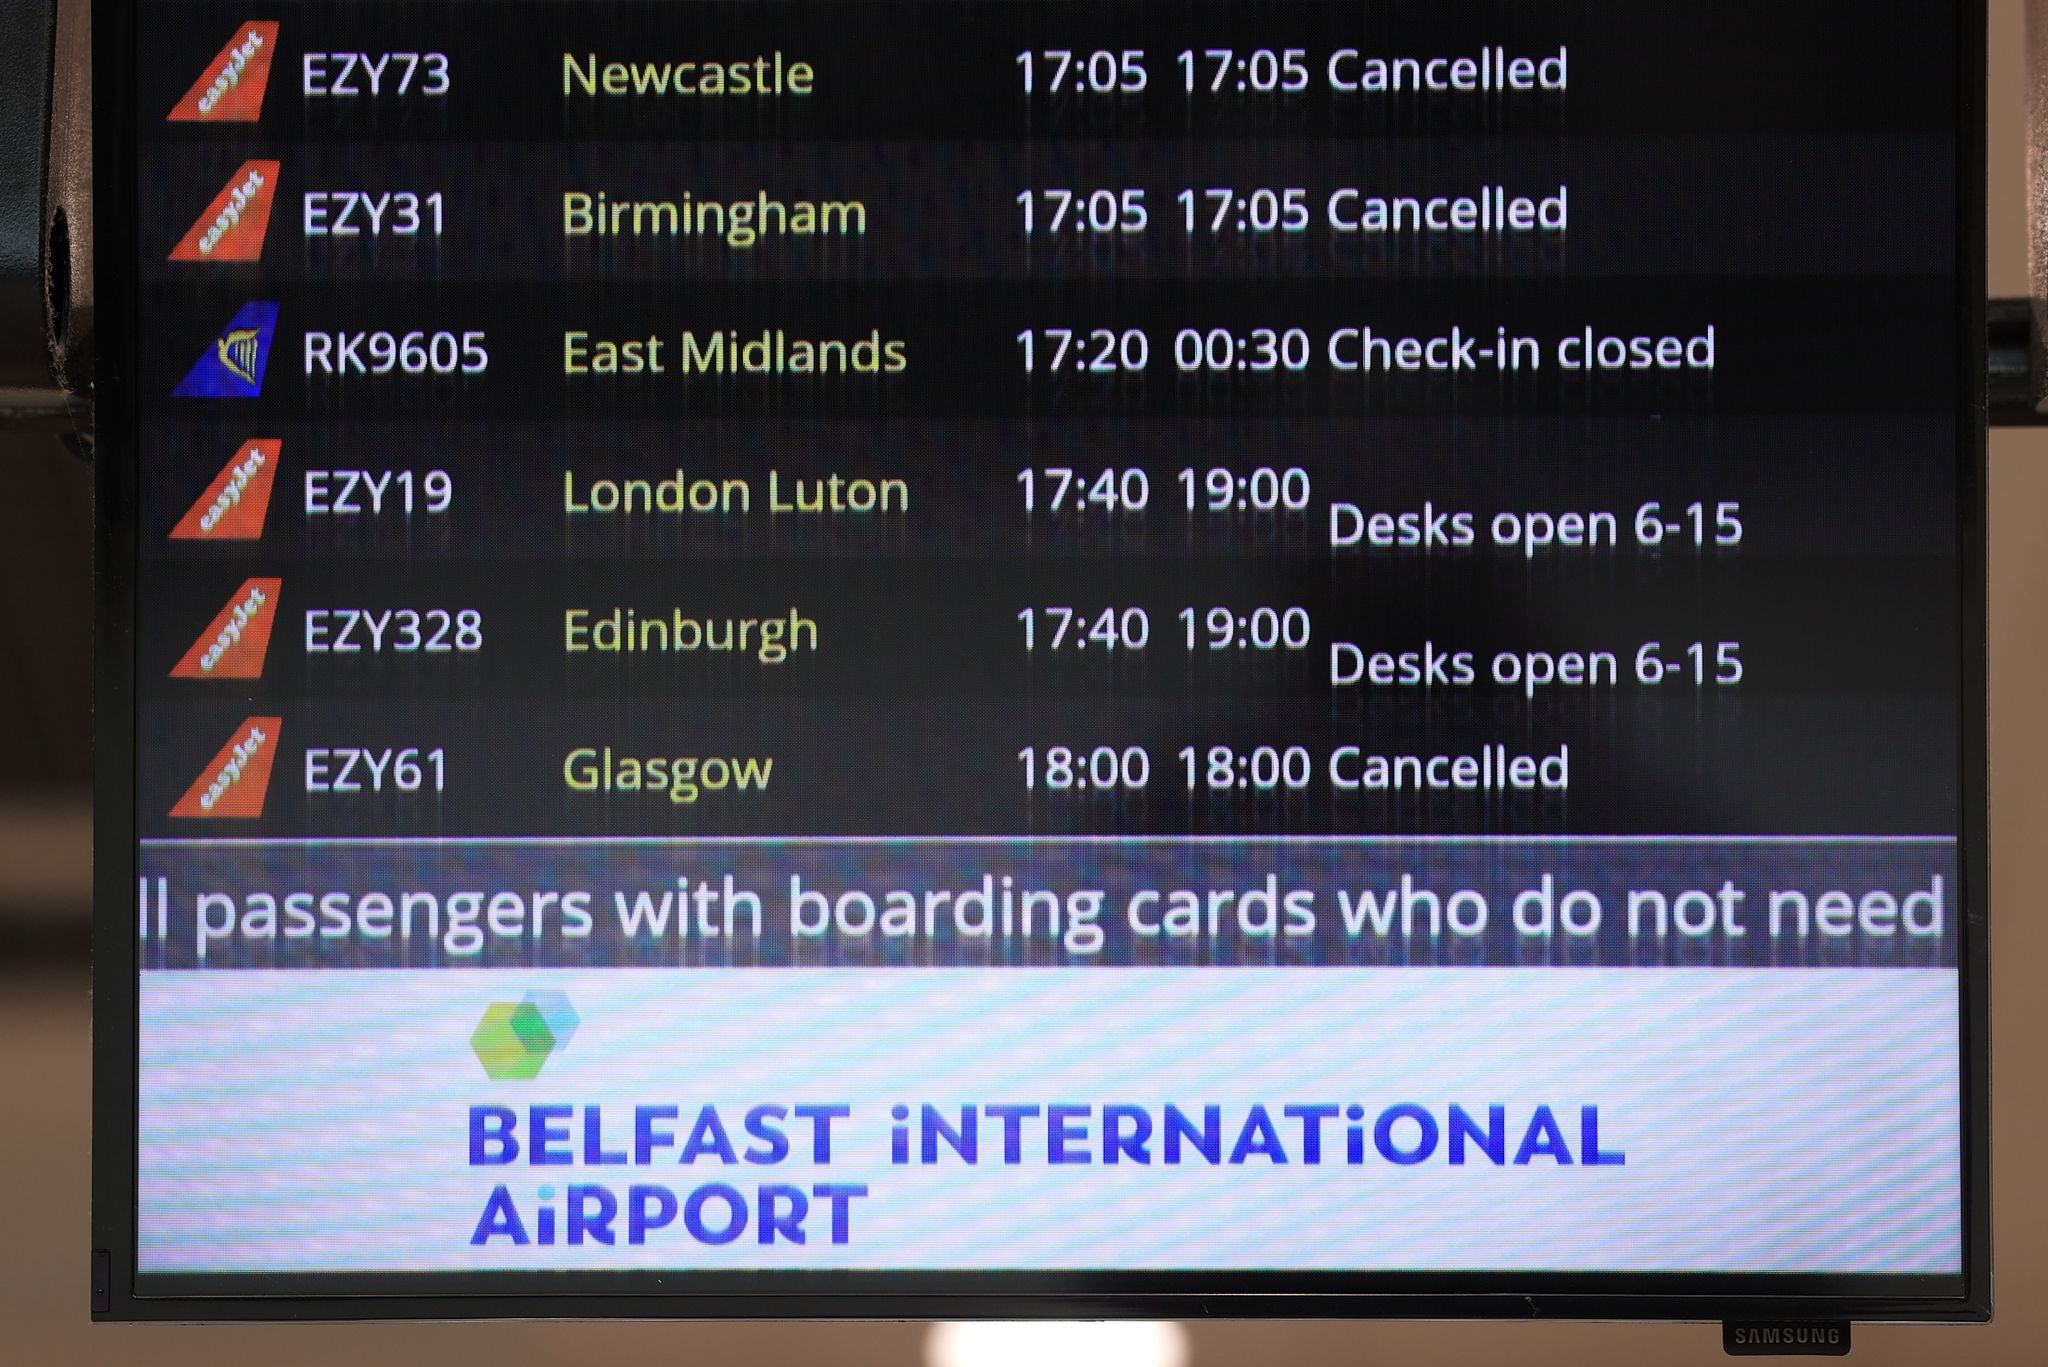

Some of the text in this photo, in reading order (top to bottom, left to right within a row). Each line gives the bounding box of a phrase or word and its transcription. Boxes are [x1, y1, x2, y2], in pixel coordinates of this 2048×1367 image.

[198, 29, 264, 113] easyJet
[304, 47, 1567, 95] EZY73 Newcastle 17:05 17:05 Cancelled
[199, 168, 265, 252] easyJet
[305, 186, 1567, 247] EZY31 Birmingham 17:05 17:05 Cancelled
[305, 325, 1714, 373] RK9605 East Midlands 17:20 00:30 Check-in closed
[200, 447, 266, 531] easyJet
[306, 467, 1310, 513] EZY19 London Luton 17:40 19:00
[1331, 502, 1742, 557] Desks open 6-15
[200, 587, 266, 671] easyJet
[306, 607, 1310, 663] EZY328 Edinburgh 17:40 19:00
[1331, 642, 1742, 697] Desks open 6-15
[201, 725, 267, 809] easyJet
[306, 745, 1568, 803] EZY61 Glasgow 18:00 18:00 Cancelled
[198, 891, 592, 957] passengers
[615, 874, 761, 937] with
[791, 874, 1104, 954] boarding
[1129, 874, 1315, 937] cards
[1338, 874, 1488, 936] who
[1513, 874, 1601, 937] do
[1628, 881, 1744, 936] not
[1770, 875, 1943, 936] need
[469, 1105, 848, 1165] BELFAST
[1735, 1328, 1840, 1344] SAMSUNG
